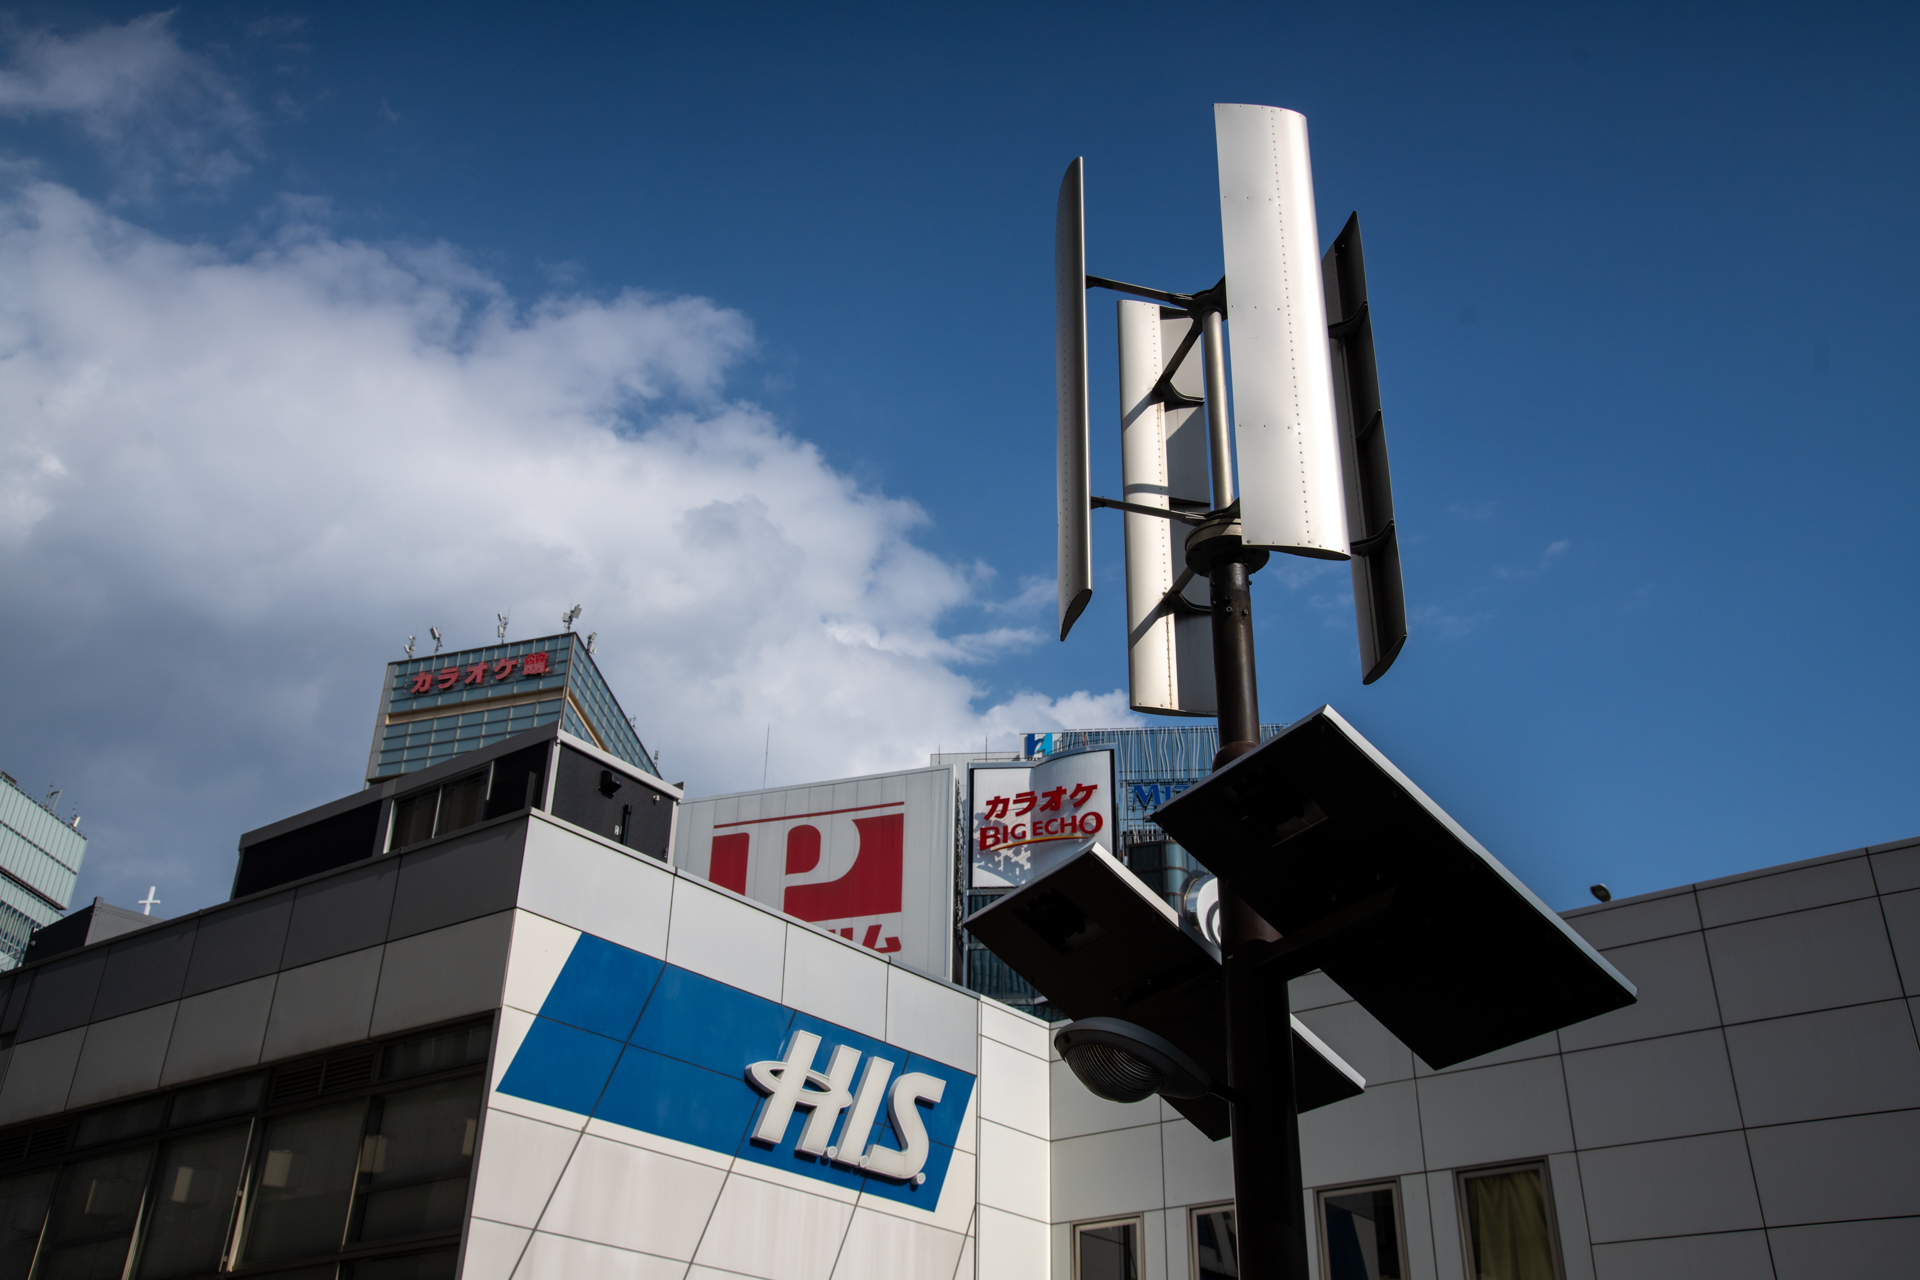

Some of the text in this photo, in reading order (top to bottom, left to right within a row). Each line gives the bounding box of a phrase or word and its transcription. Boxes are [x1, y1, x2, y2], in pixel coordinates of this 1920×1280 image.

[983, 783, 1098, 821] カラオケ
[979, 811, 1104, 851] BIG ECHO
